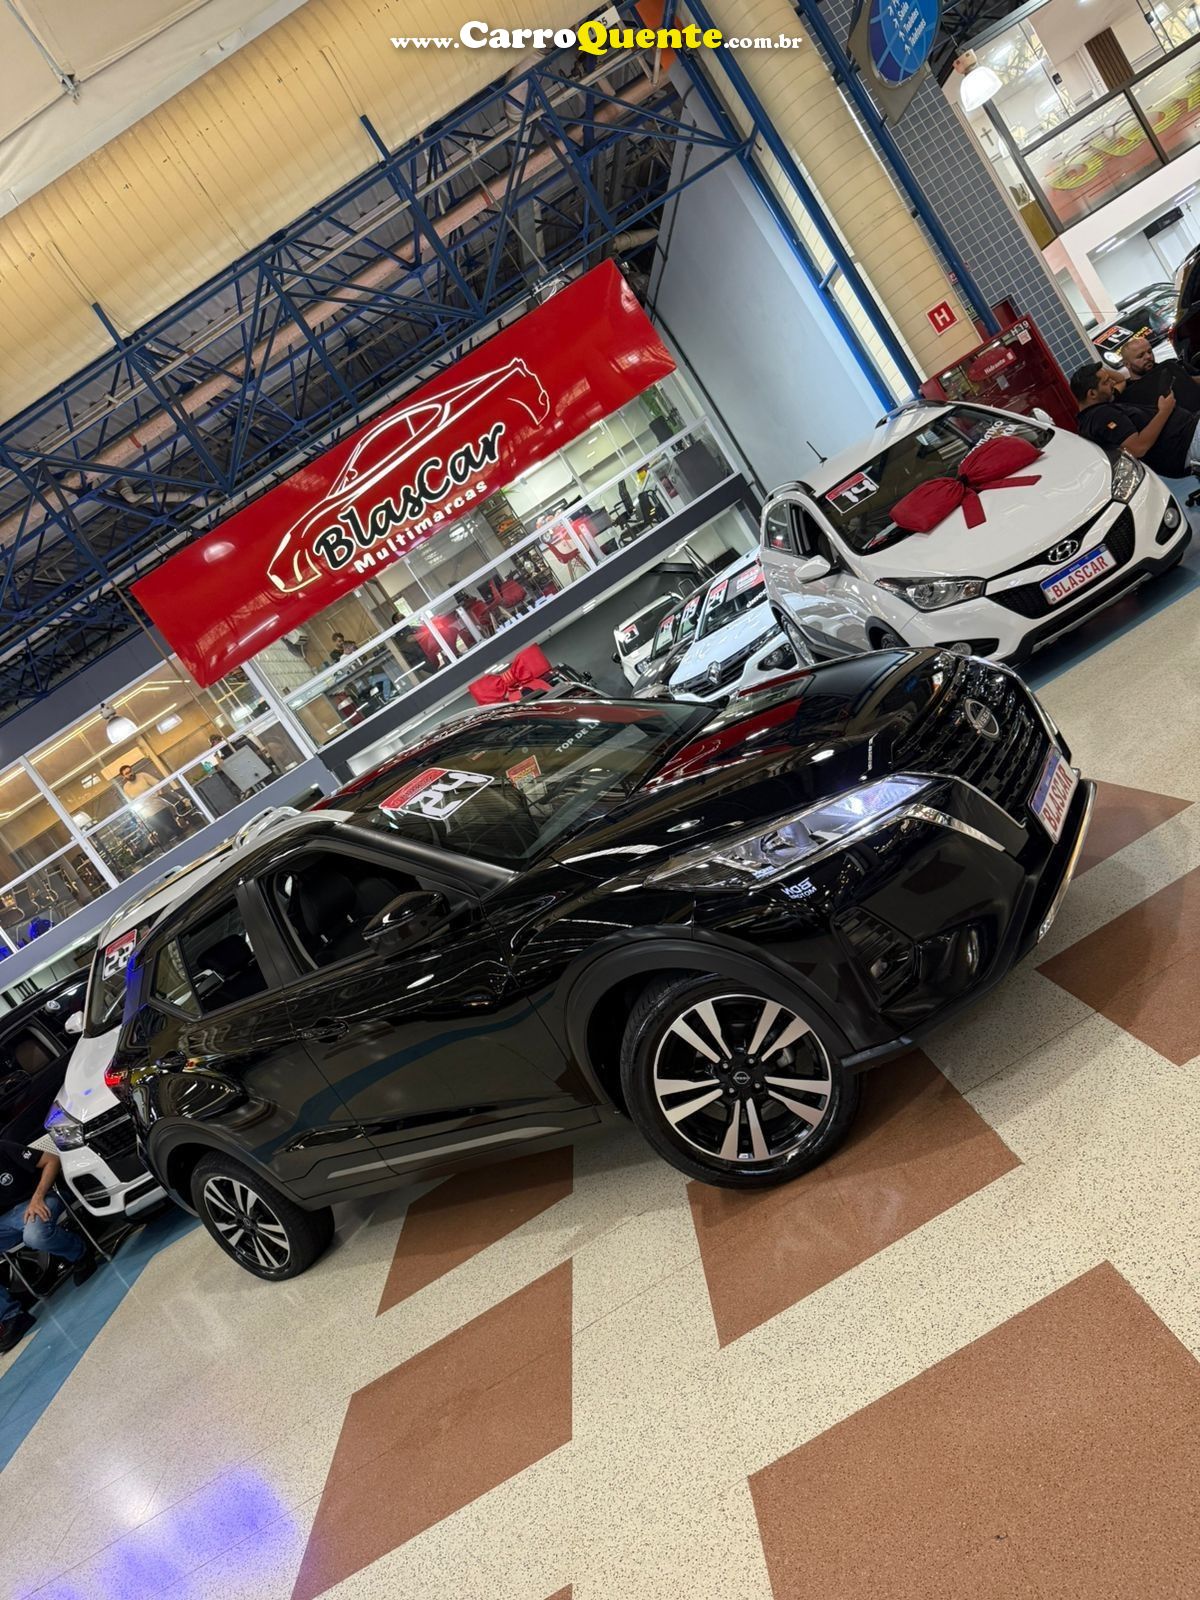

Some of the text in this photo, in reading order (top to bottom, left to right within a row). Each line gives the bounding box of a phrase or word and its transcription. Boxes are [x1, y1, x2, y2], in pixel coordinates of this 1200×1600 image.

[934, 308, 950, 327] H
[313, 421, 506, 570] BlasCar
[842, 479, 877, 503] 14
[353, 481, 488, 573] Multimarcas
[1051, 555, 1108, 598] BLASCAR
[555, 738, 574, 752] TOP
[575, 728, 589, 739] DE
[406, 772, 488, 817] 24
[1042, 763, 1073, 832] BLASCAR
